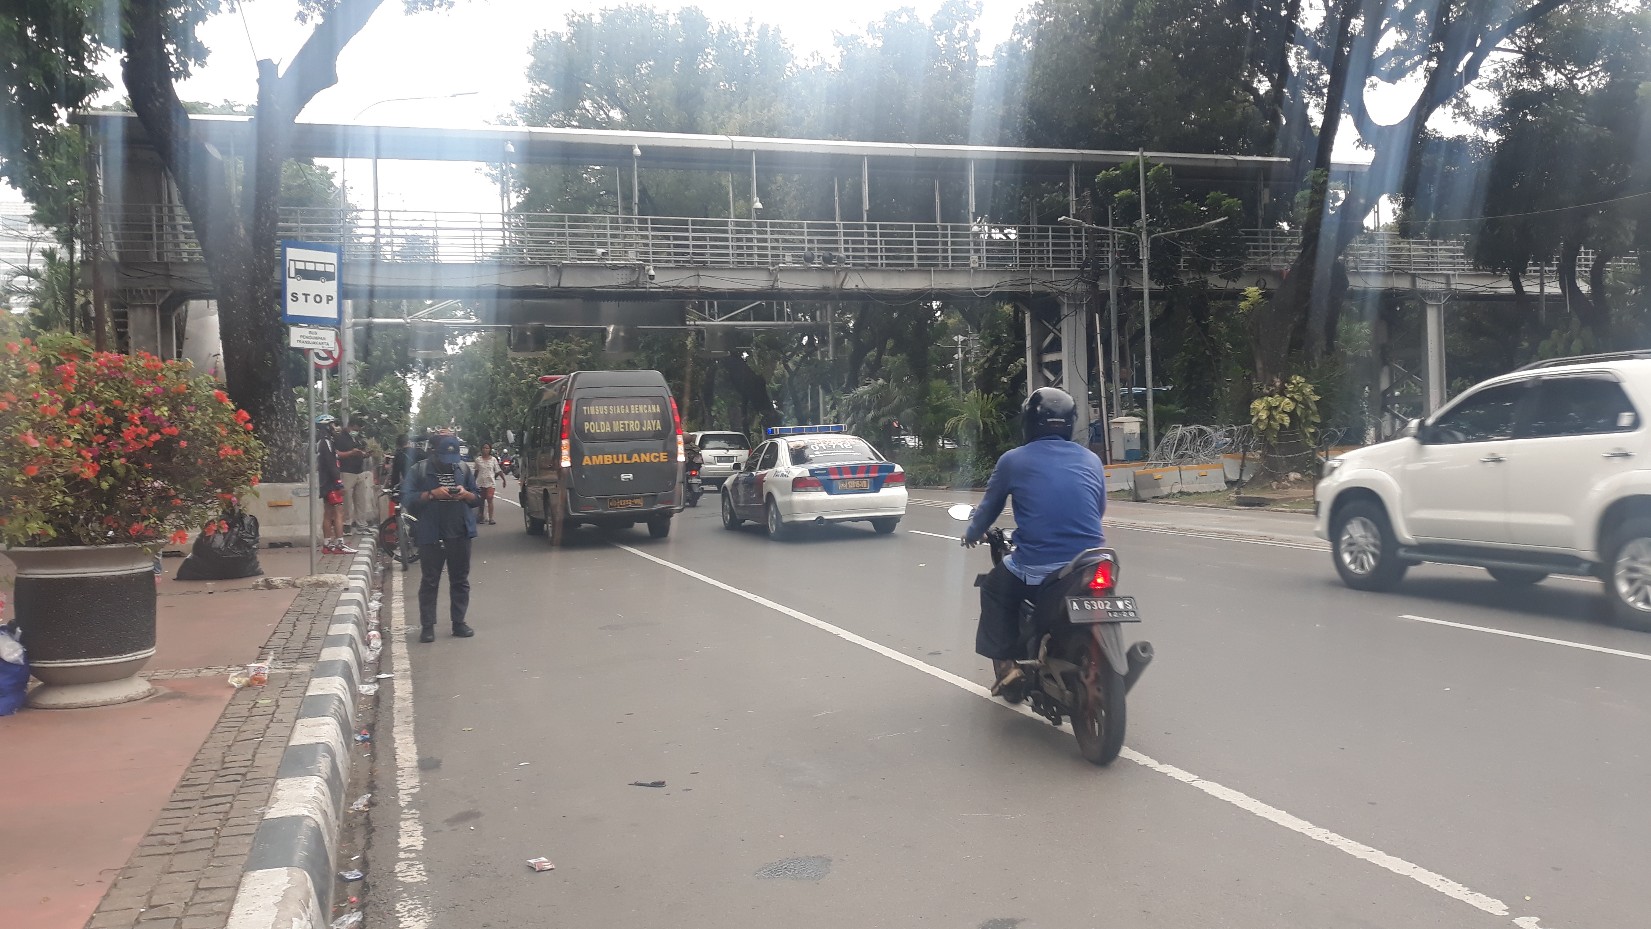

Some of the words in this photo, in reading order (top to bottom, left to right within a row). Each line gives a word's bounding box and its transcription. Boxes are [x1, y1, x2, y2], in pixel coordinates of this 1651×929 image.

[290, 292, 334, 304] STOP
[583, 406, 608, 415] TIMSUS
[610, 406, 629, 414] SIAGA
[631, 405, 660, 413] BENCANA
[584, 422, 611, 432] POLDA
[612, 420, 641, 432] METRO
[642, 419, 662, 431] JAYA
[582, 453, 668, 465] AMBULANCE
[1072, 601, 1080, 611] A
[1083, 600, 1112, 610] 6302
[1115, 600, 1133, 610] WS
